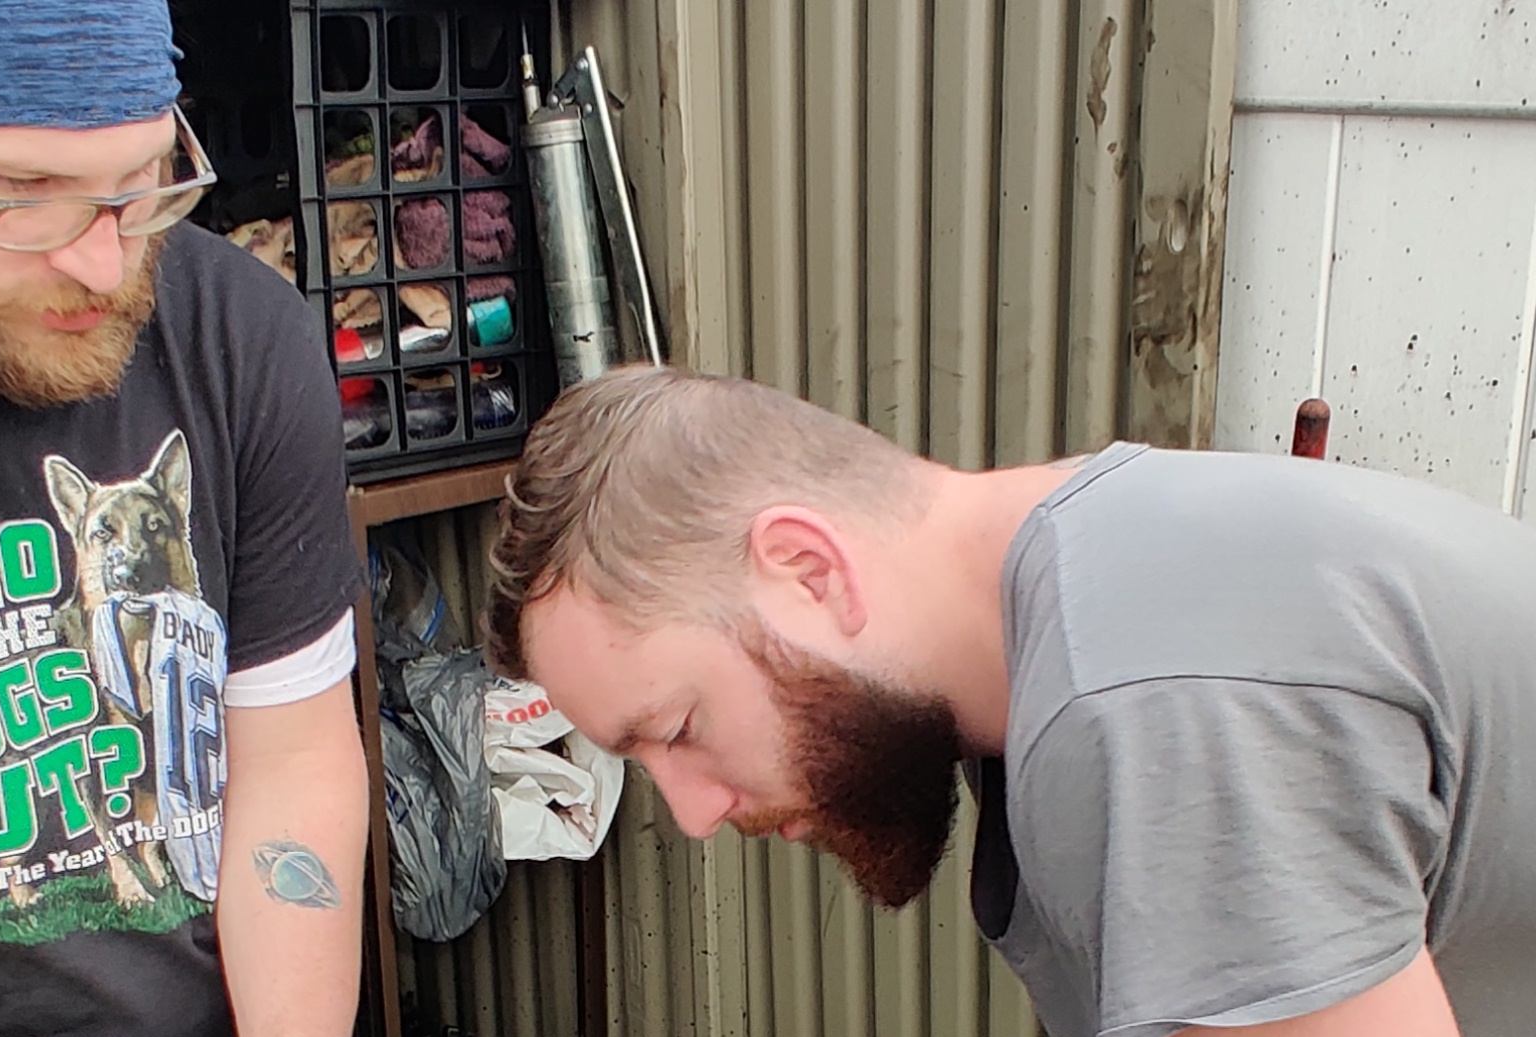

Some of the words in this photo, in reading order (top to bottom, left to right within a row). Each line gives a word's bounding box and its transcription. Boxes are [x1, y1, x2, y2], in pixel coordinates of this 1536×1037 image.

[160, 654, 223, 812] 12
[48, 845, 105, 873] Year
[115, 819, 168, 848] The
